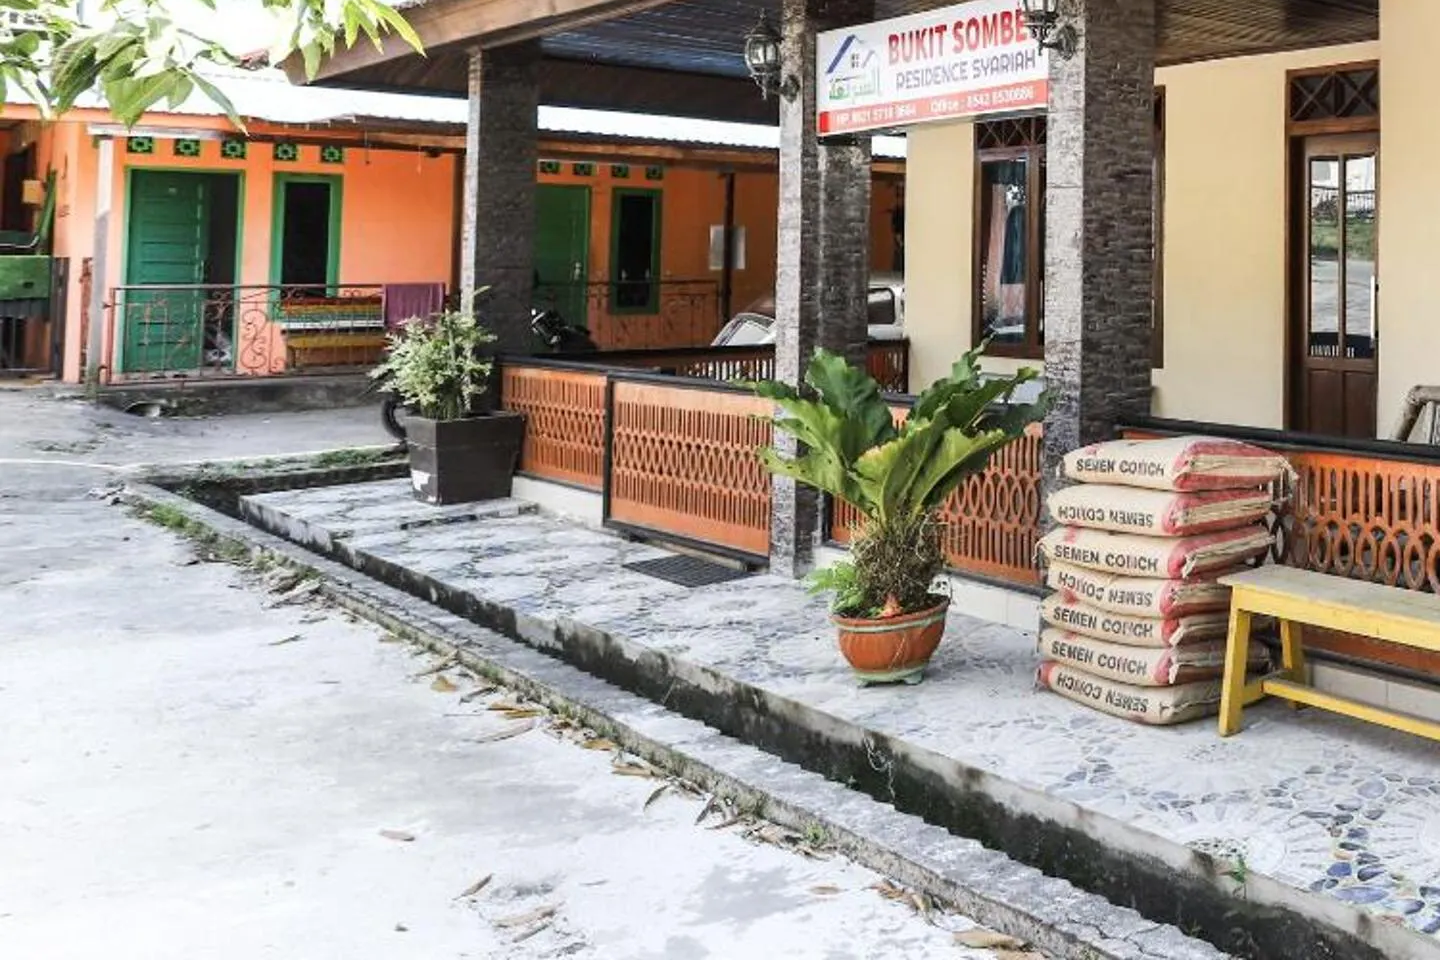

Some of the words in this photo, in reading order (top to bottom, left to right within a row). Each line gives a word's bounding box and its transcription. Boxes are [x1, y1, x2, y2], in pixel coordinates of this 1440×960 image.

[888, 24, 947, 65] BUKIT
[952, 8, 1028, 55] SOMBE
[896, 61, 968, 90] RESIDENCE
[972, 49, 1036, 79] SYARIAH
[1054, 545, 1100, 564] SEMEN
[1108, 589, 1153, 607] SEMEN
[1053, 606, 1097, 629] SEMEN
[1051, 641, 1094, 663] SEMEN
[1105, 689, 1149, 713] SEMEN
